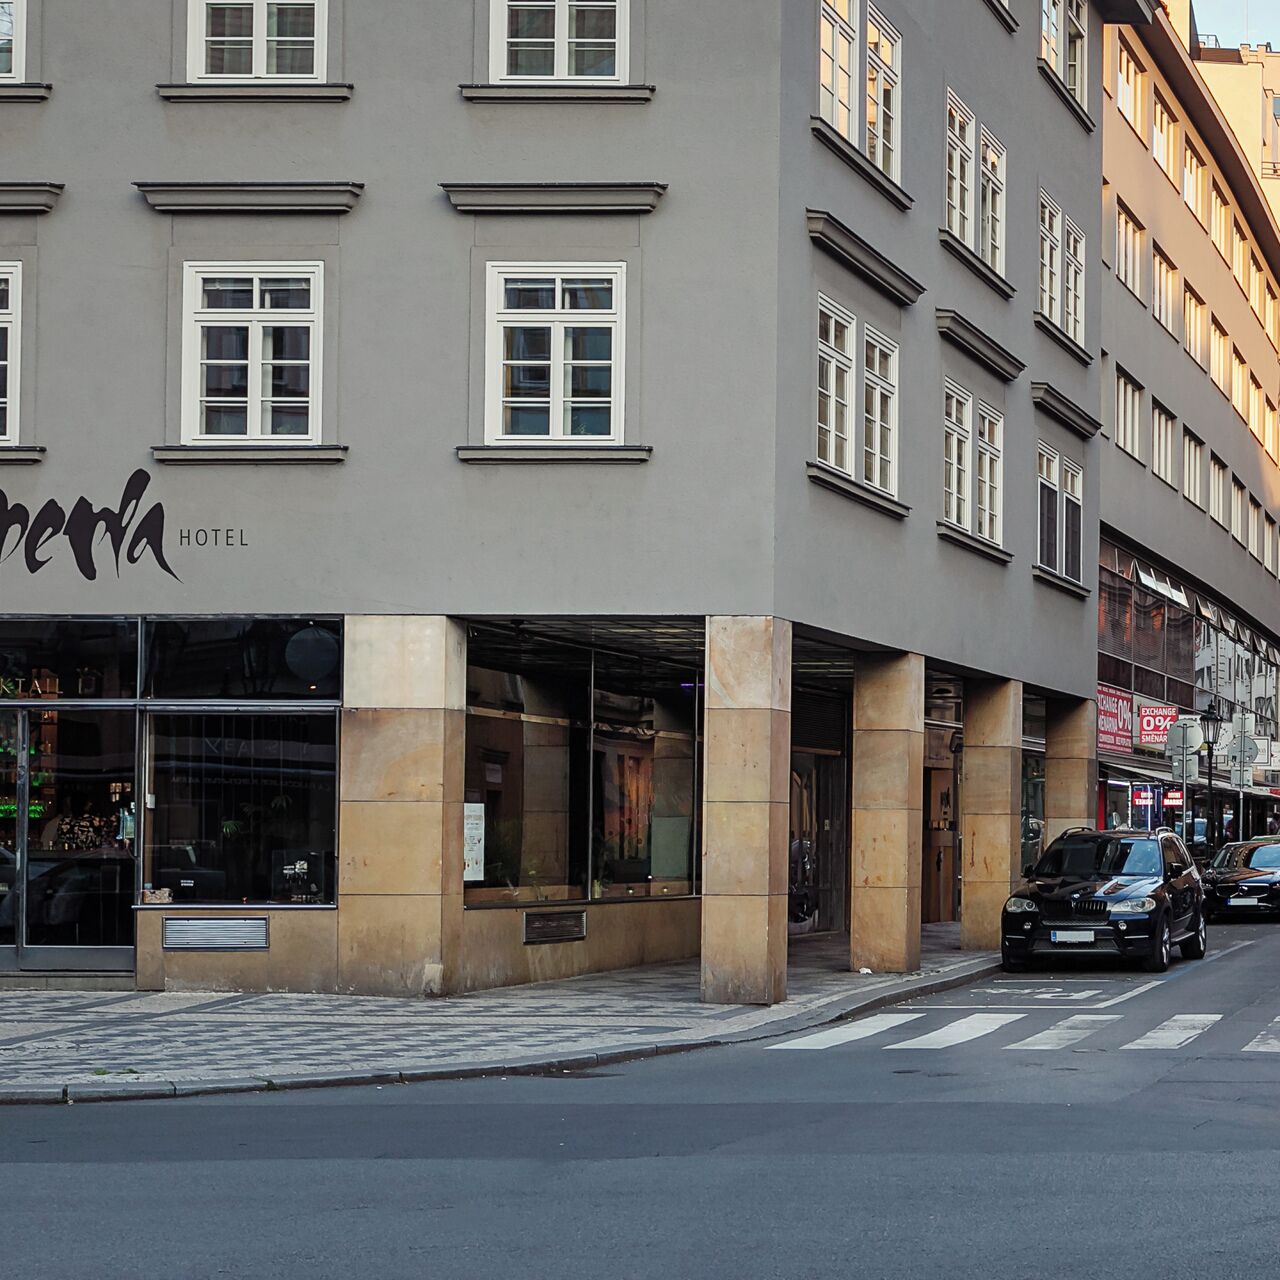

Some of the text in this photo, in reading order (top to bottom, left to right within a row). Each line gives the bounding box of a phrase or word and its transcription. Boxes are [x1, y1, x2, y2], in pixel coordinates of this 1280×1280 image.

[180, 529, 248, 546] HOTEL
[1117, 699, 1132, 732] 0%
[1141, 707, 1177, 716] EXCHANGE
[1142, 716, 1174, 731] 0%
[1141, 733, 1168, 743] SMĚNÁR
